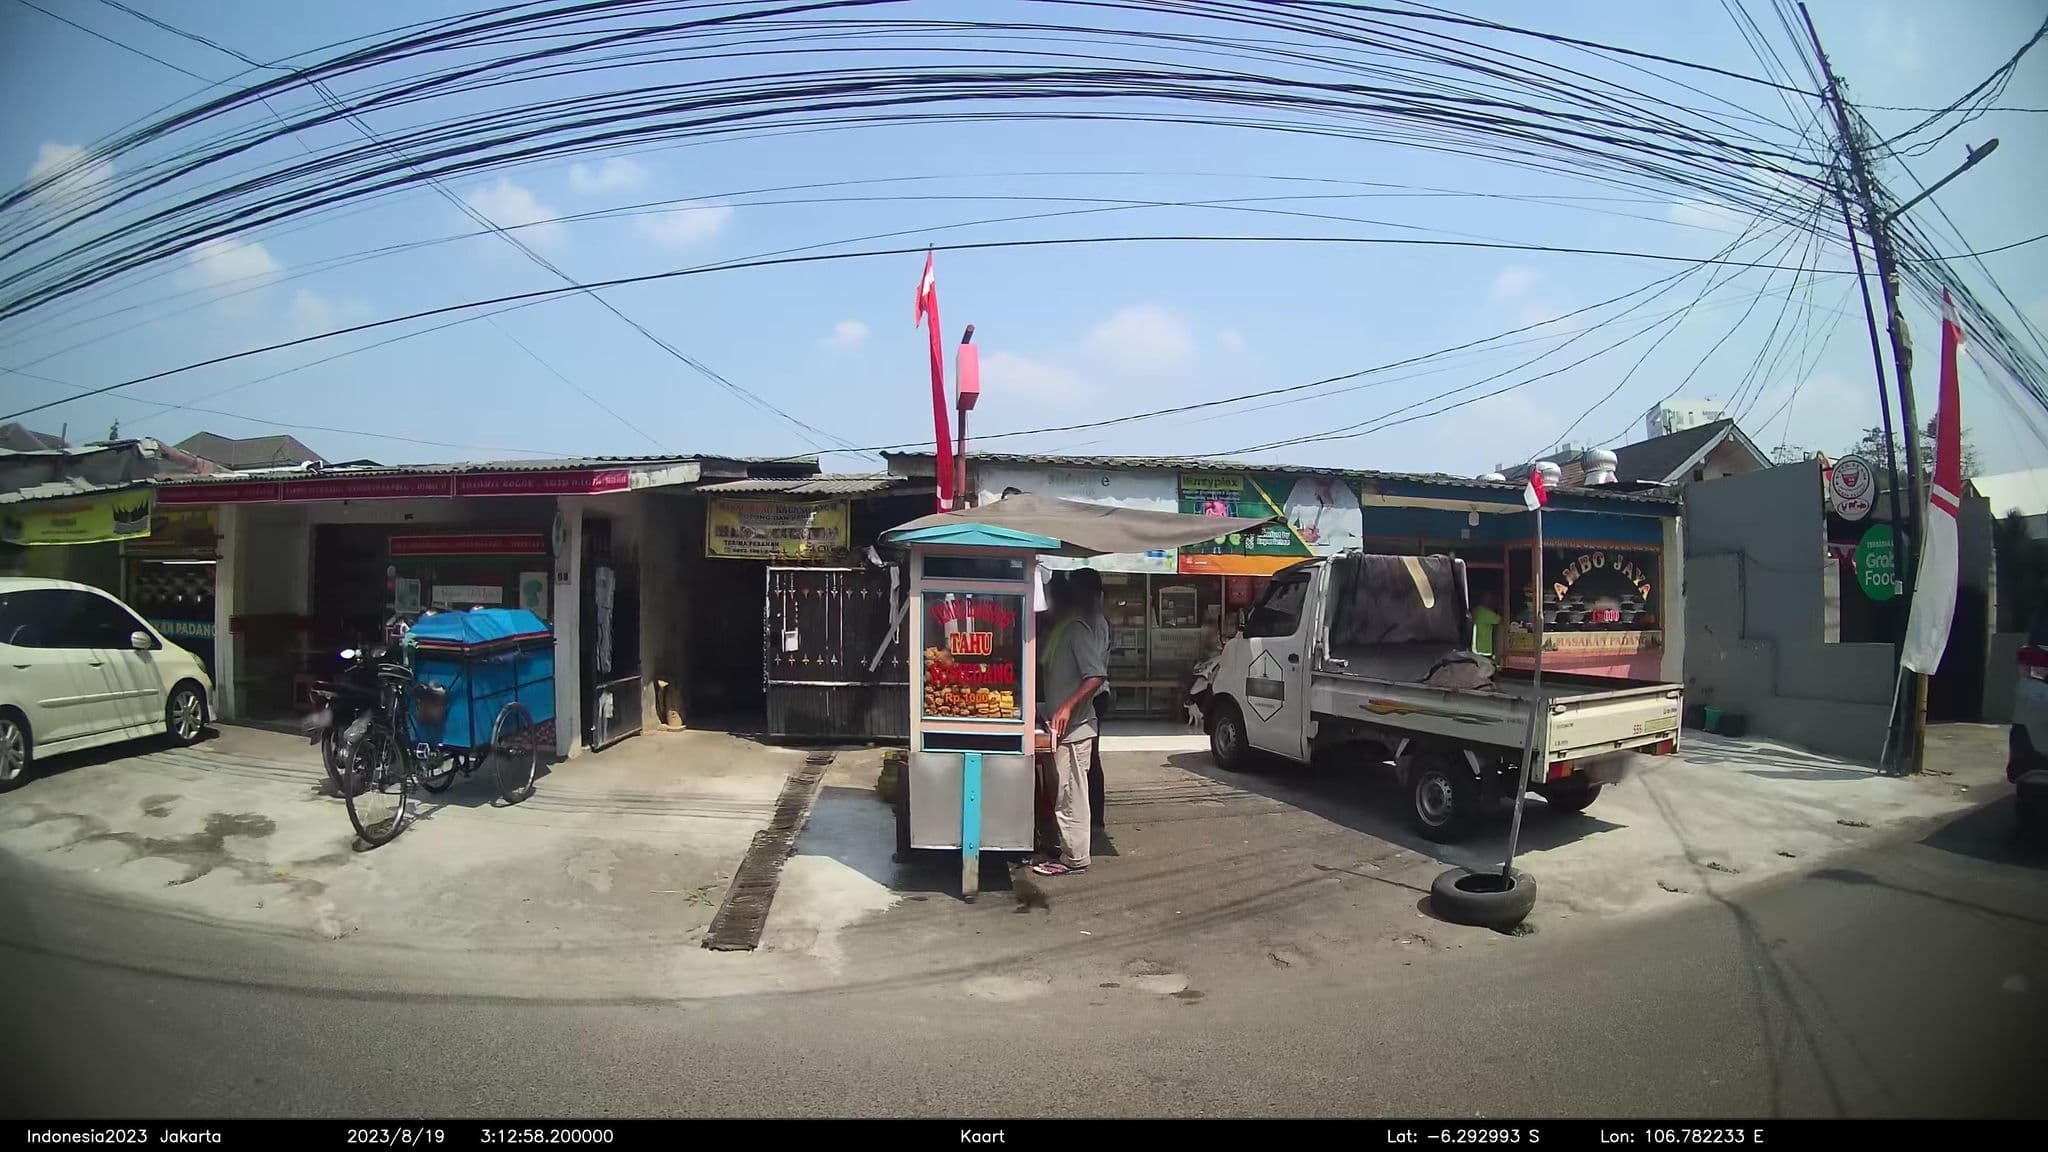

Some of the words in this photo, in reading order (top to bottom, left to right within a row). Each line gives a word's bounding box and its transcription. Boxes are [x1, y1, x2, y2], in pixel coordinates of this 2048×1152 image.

[1554, 551, 1605, 600] AMBO
[1613, 554, 1651, 600] JAYA
[950, 632, 993, 656] TAHU
[1556, 636, 1606, 647] MASAKAN
